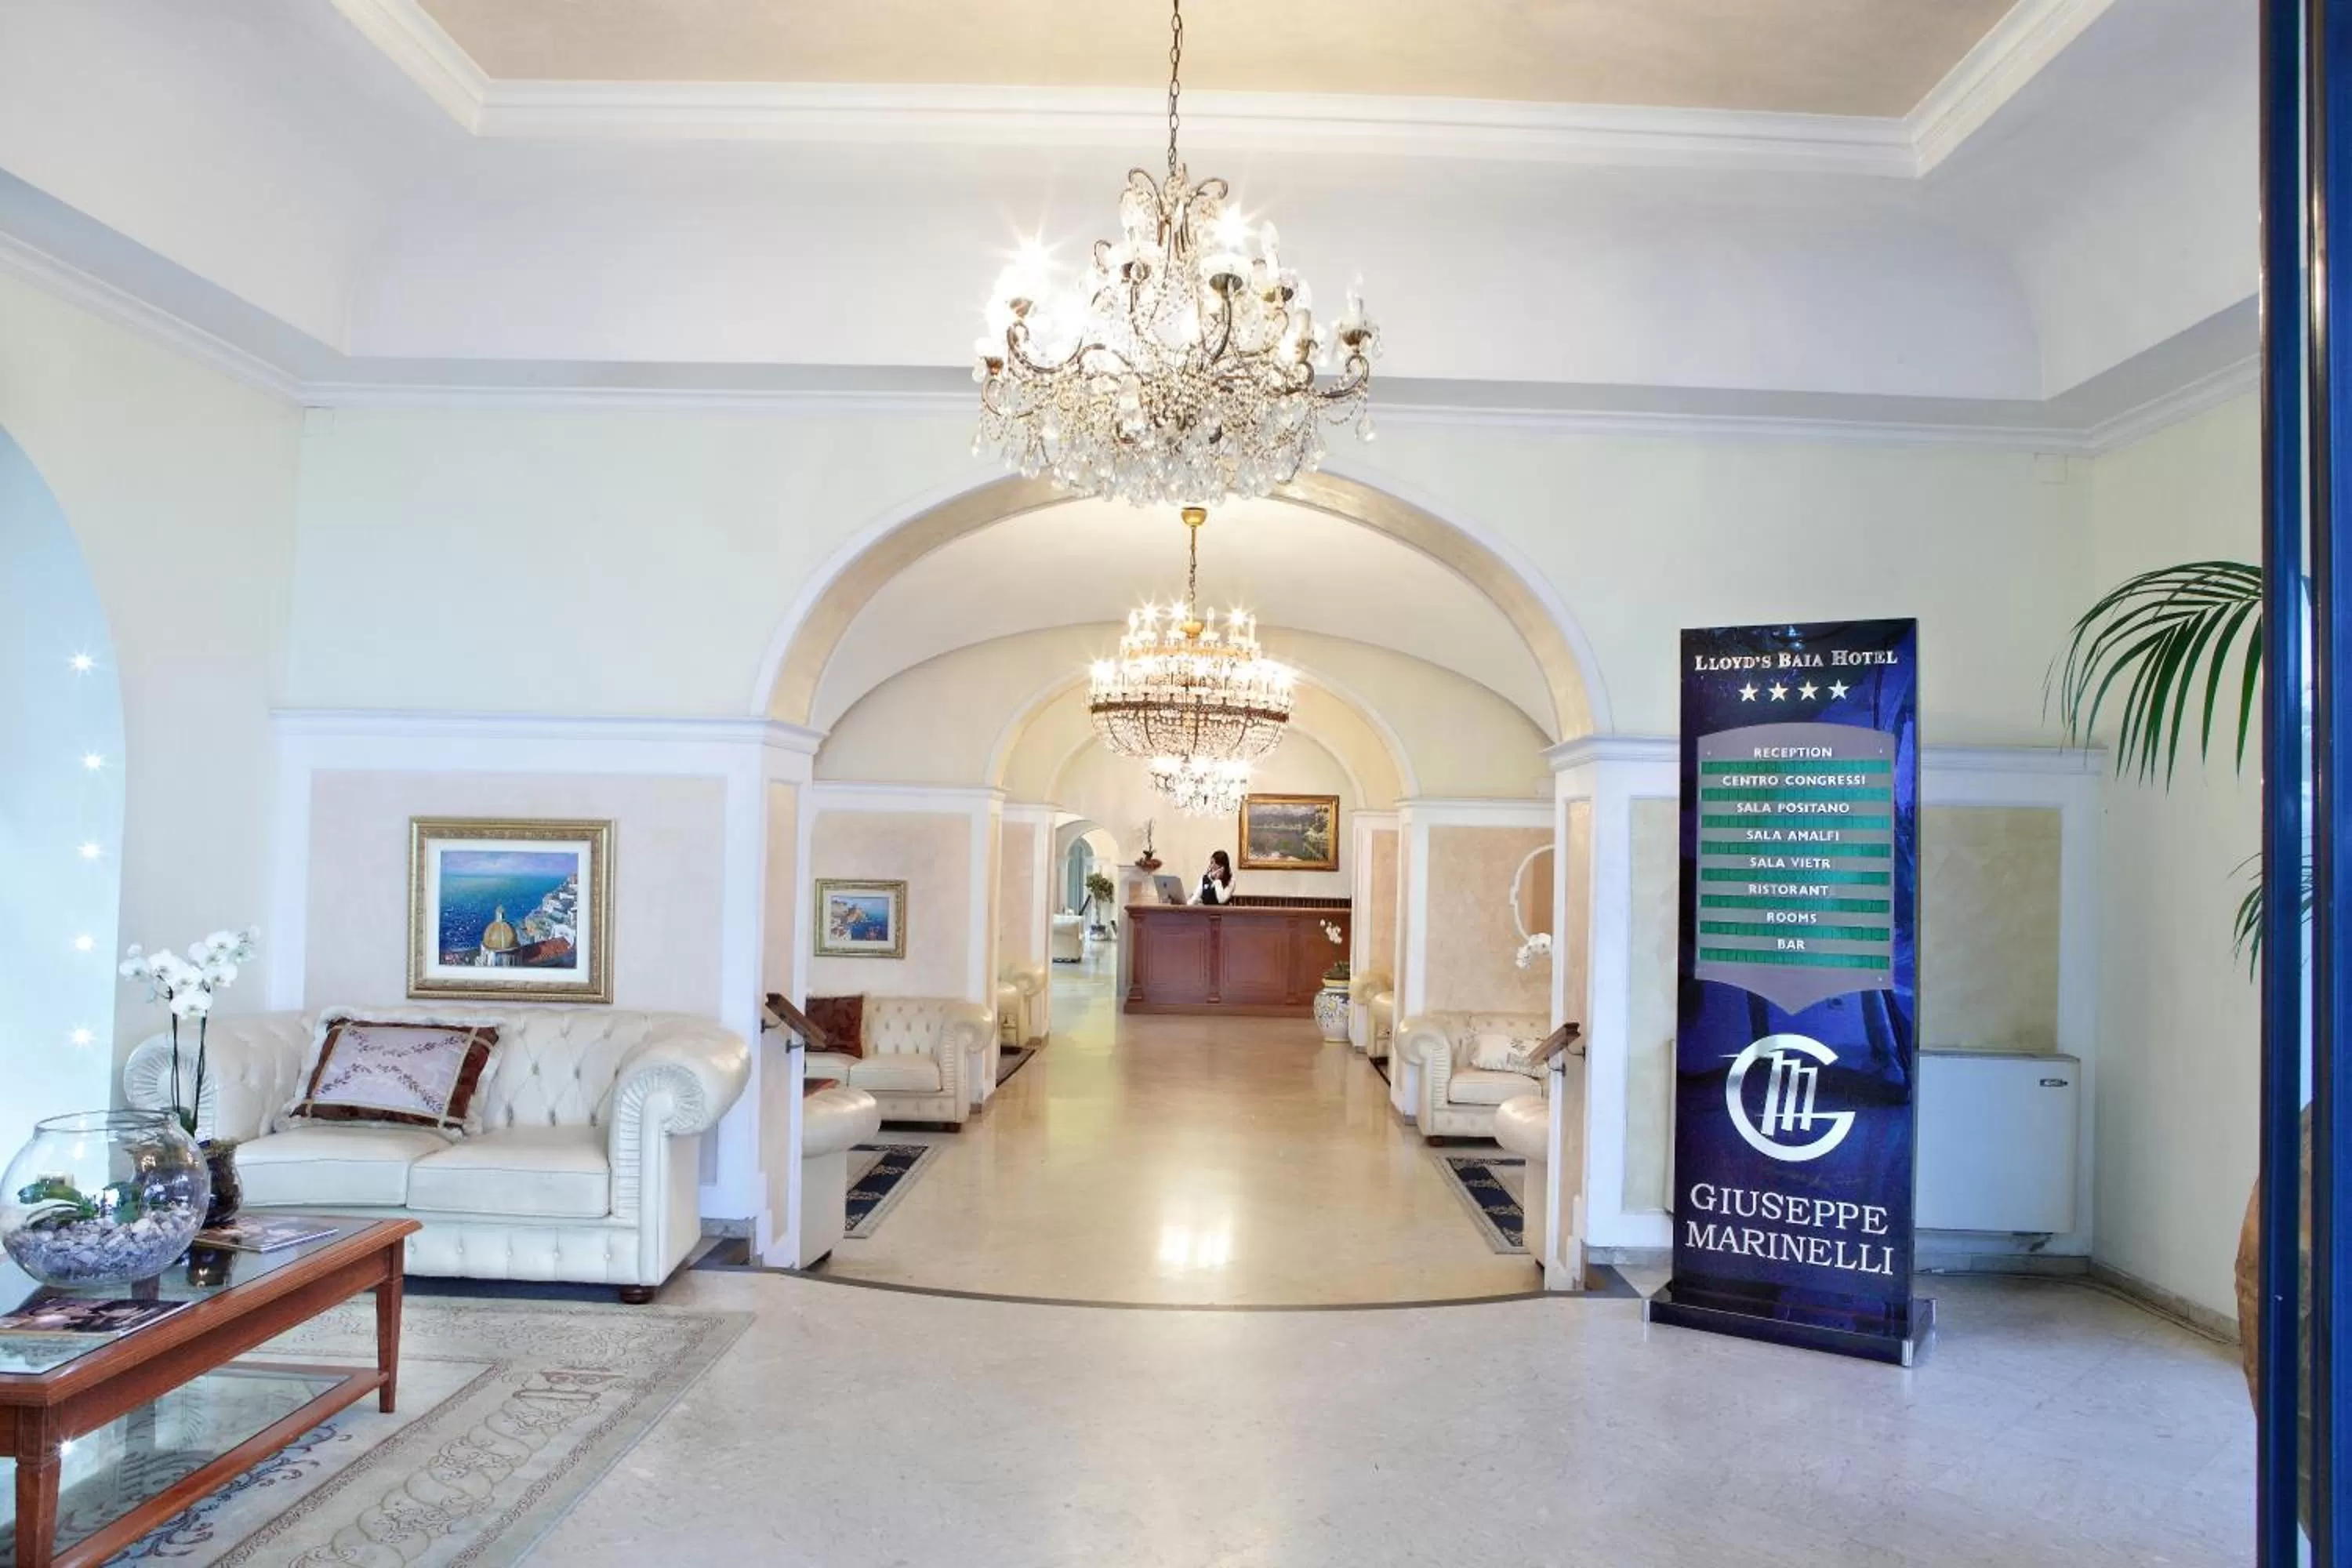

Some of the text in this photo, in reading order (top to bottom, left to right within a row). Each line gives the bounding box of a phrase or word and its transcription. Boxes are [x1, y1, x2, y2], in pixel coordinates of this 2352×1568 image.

[1695, 650, 1898, 670] LLOYD'S BAIA HOTEL
[1754, 747, 1832, 758] RECEPTION
[1722, 775, 1865, 786] CENTRO CONGRESSI
[1737, 802, 1849, 813] SALA POSITANO
[1746, 830, 1839, 841] SALA AMALFI
[1750, 857, 1831, 869] SALA VIETR
[1766, 912, 1817, 924] ROOMS
[1777, 939, 1806, 950] BAR
[1690, 1182, 1889, 1235] GIUSEPPE
[1685, 1220, 1894, 1276] MARINELLI
